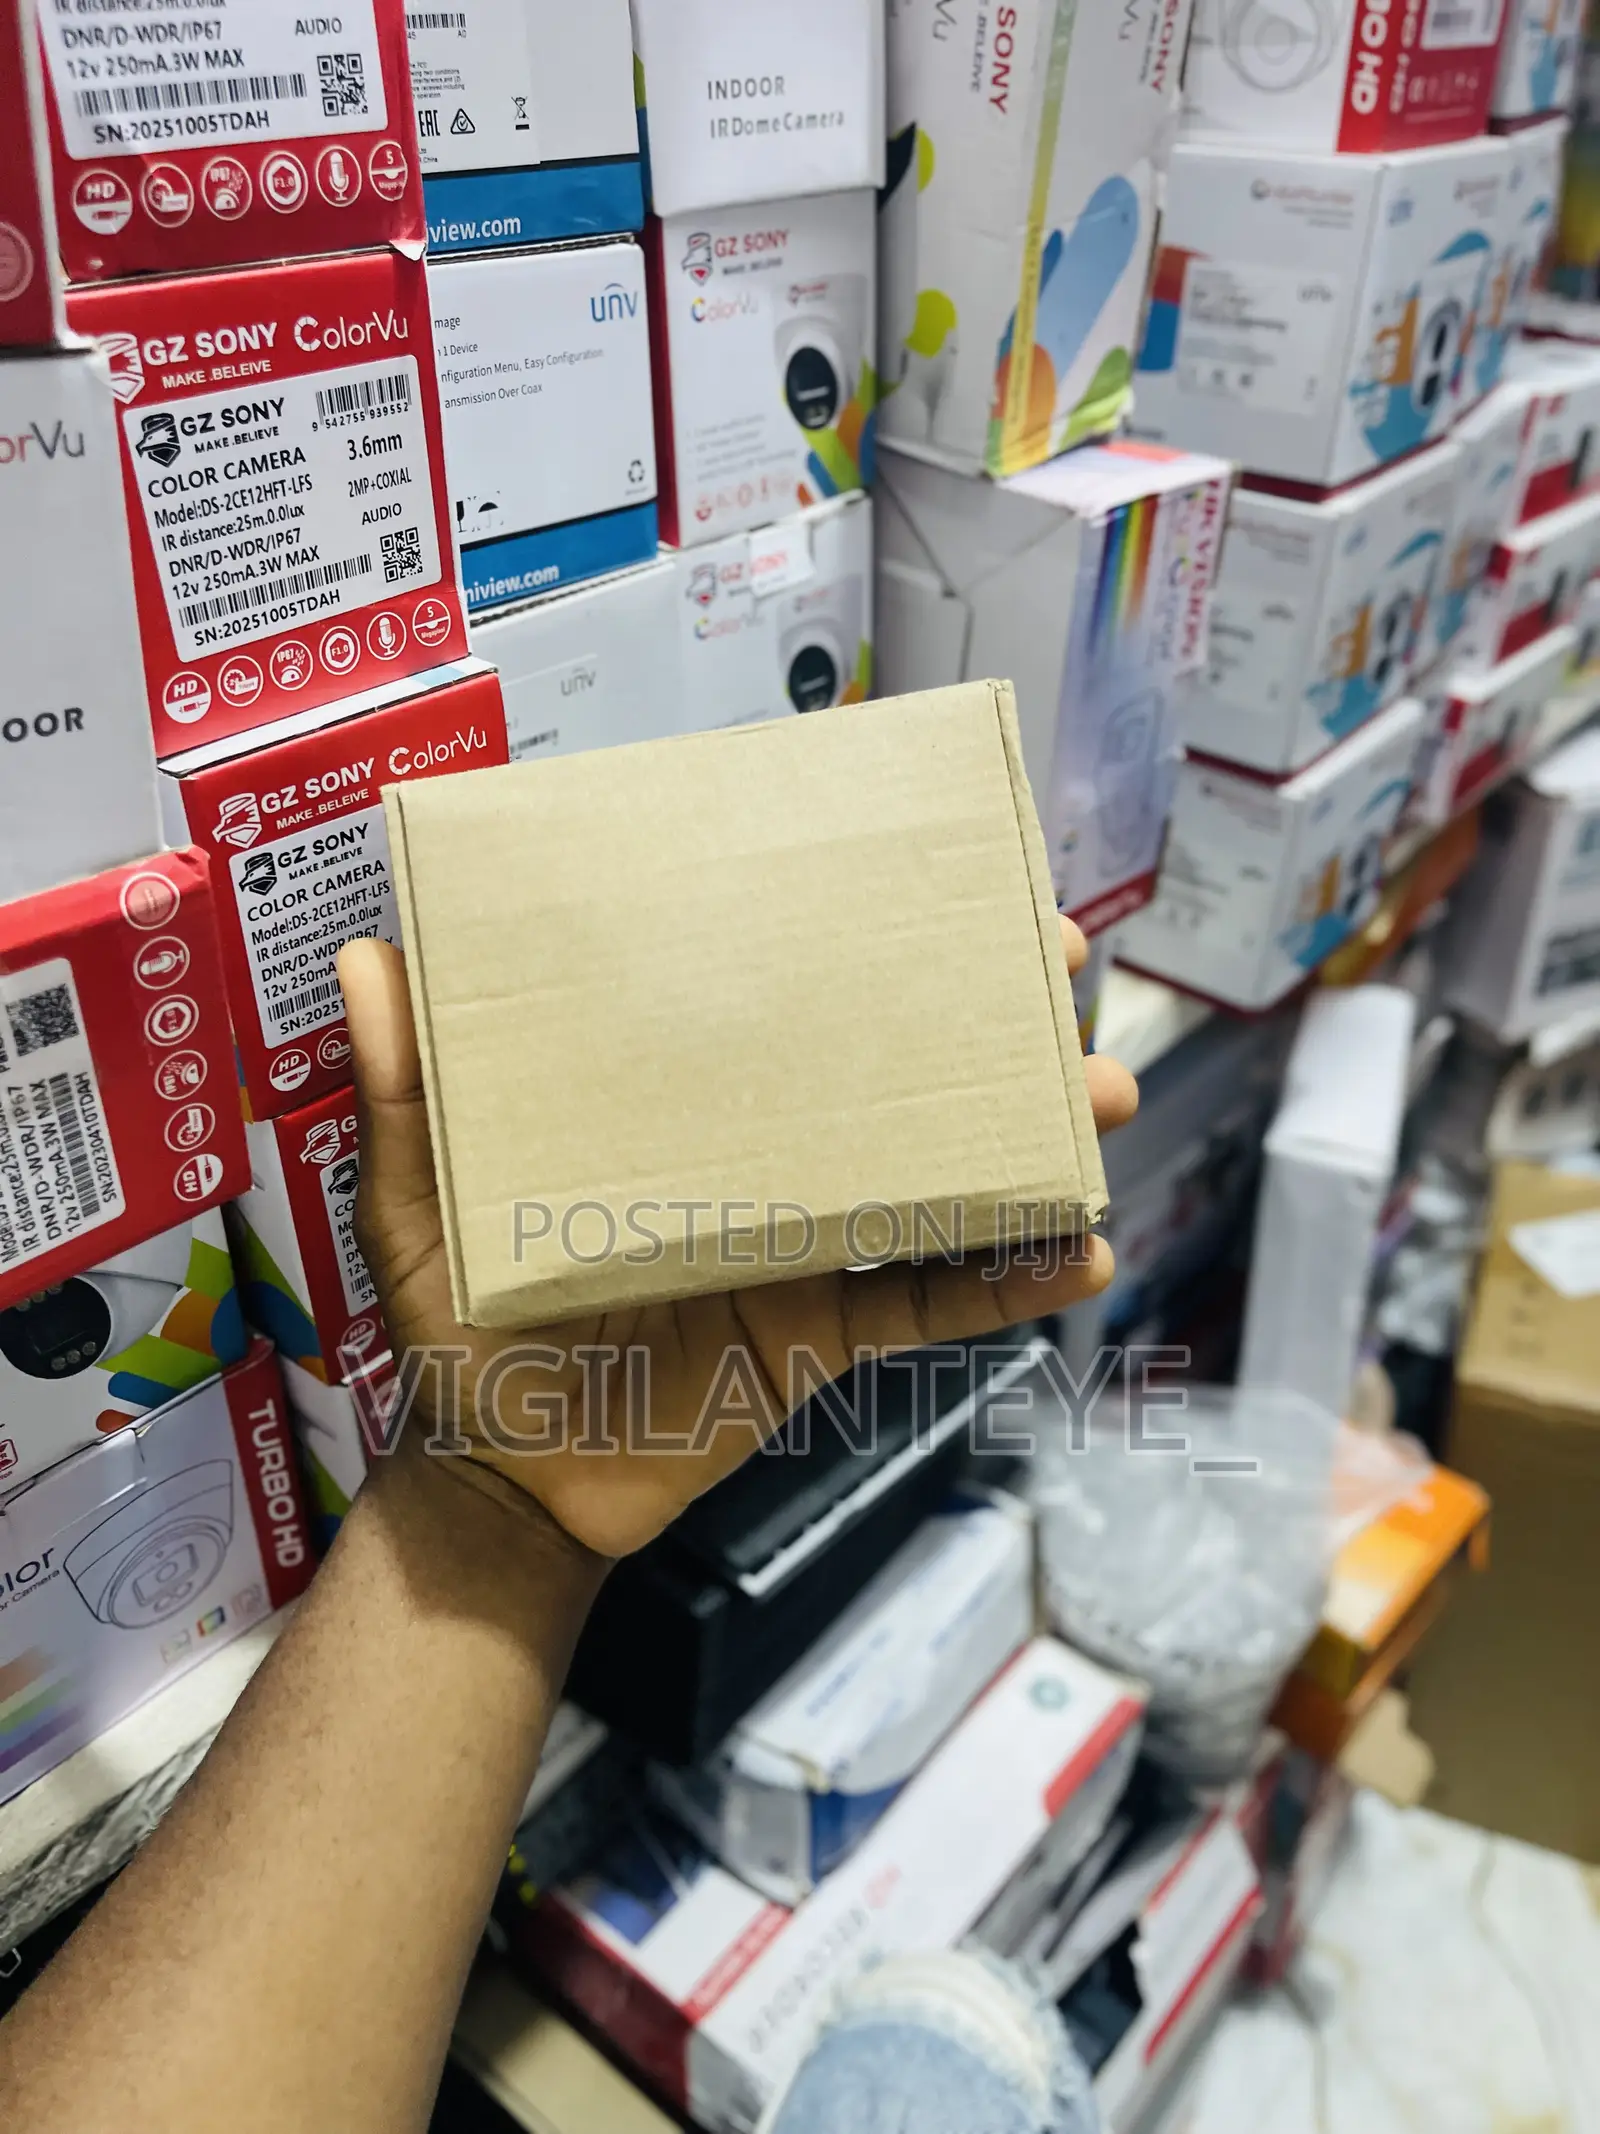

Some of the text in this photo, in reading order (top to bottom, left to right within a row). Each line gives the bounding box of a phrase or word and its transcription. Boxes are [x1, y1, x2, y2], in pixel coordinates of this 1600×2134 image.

[61, 20, 222, 49] DNR/D-WDR/IP67
[294, 18, 343, 38] AUDIO
[989, 6, 1017, 114] SONY
[1151, 0, 1180, 94] SONY
[66, 49, 245, 79] 12v 250mA.3W MAX
[707, 76, 785, 100] INDOOR
[94, 110, 271, 144] SN:20251005TDAH
[385, 150, 395, 165] 5
[85, 181, 115, 200] HD
[429, 217, 522, 243] view.com
[714, 228, 790, 258] GZ SONY
[293, 308, 409, 352] ColorVu
[434, 316, 462, 331] mage
[142, 321, 278, 367] GZ SONY
[449, 342, 479, 356] Device
[162, 370, 207, 389] MAKE
[440, 348, 604, 385] nfiguration Menu, Easy Configuration
[444, 383, 543, 410] ansmission Over Coax
[180, 396, 285, 437] GZ SONY
[312, 402, 410, 433] 9 542755 939552
[194, 425, 280, 455] MAKE .BELIEVE
[347, 433, 404, 461] 3.6mm
[148, 446, 307, 498] COLOR CAMERA
[347, 467, 413, 499] 2MP+COXIAL
[153, 474, 314, 530] Model:DS-2CE12HFT-LFS
[361, 502, 403, 526] AUDIO
[161, 503, 306, 552] IR distance:25m.0.0lux
[168, 527, 302, 578] DNR/D-WDR/IP67
[172, 544, 321, 601] 12v 250mA.3W MAX
[194, 588, 342, 647] SN:20251005TDAH
[426, 606, 435, 619] 5
[331, 644, 350, 657] F1.0
[173, 680, 199, 699] HD
[1, 706, 85, 743] OOR
[388, 725, 488, 776] ColorVu
[260, 757, 375, 815] GZ SONY
[276, 808, 314, 831] MAKE
[277, 822, 370, 869] GZ SONY
[288, 862, 320, 881] MAKE
[247, 859, 386, 922] COLOR CAMERA
[251, 879, 391, 946] Model:DS-2CE12HFT-LFS
[256, 904, 383, 963] IR distance:25m.0.0lux
[263, 982, 288, 1001] 12v
[278, 1054, 300, 1073] HD
[74, 1071, 118, 1204] SN:20230410TDAH
[8, 1085, 63, 1241] DNR/D-WDR/IP67
[30, 1077, 83, 1234] 12v 250mA.3W MAX
[182, 1168, 199, 1195] HD
[22, 1232, 42, 1254] IR
[341, 1235, 354, 1249] IR
[348, 1323, 368, 1340] HD
[248, 1398, 305, 1568] TURBO HD
[11, 1568, 60, 1603] Camera
